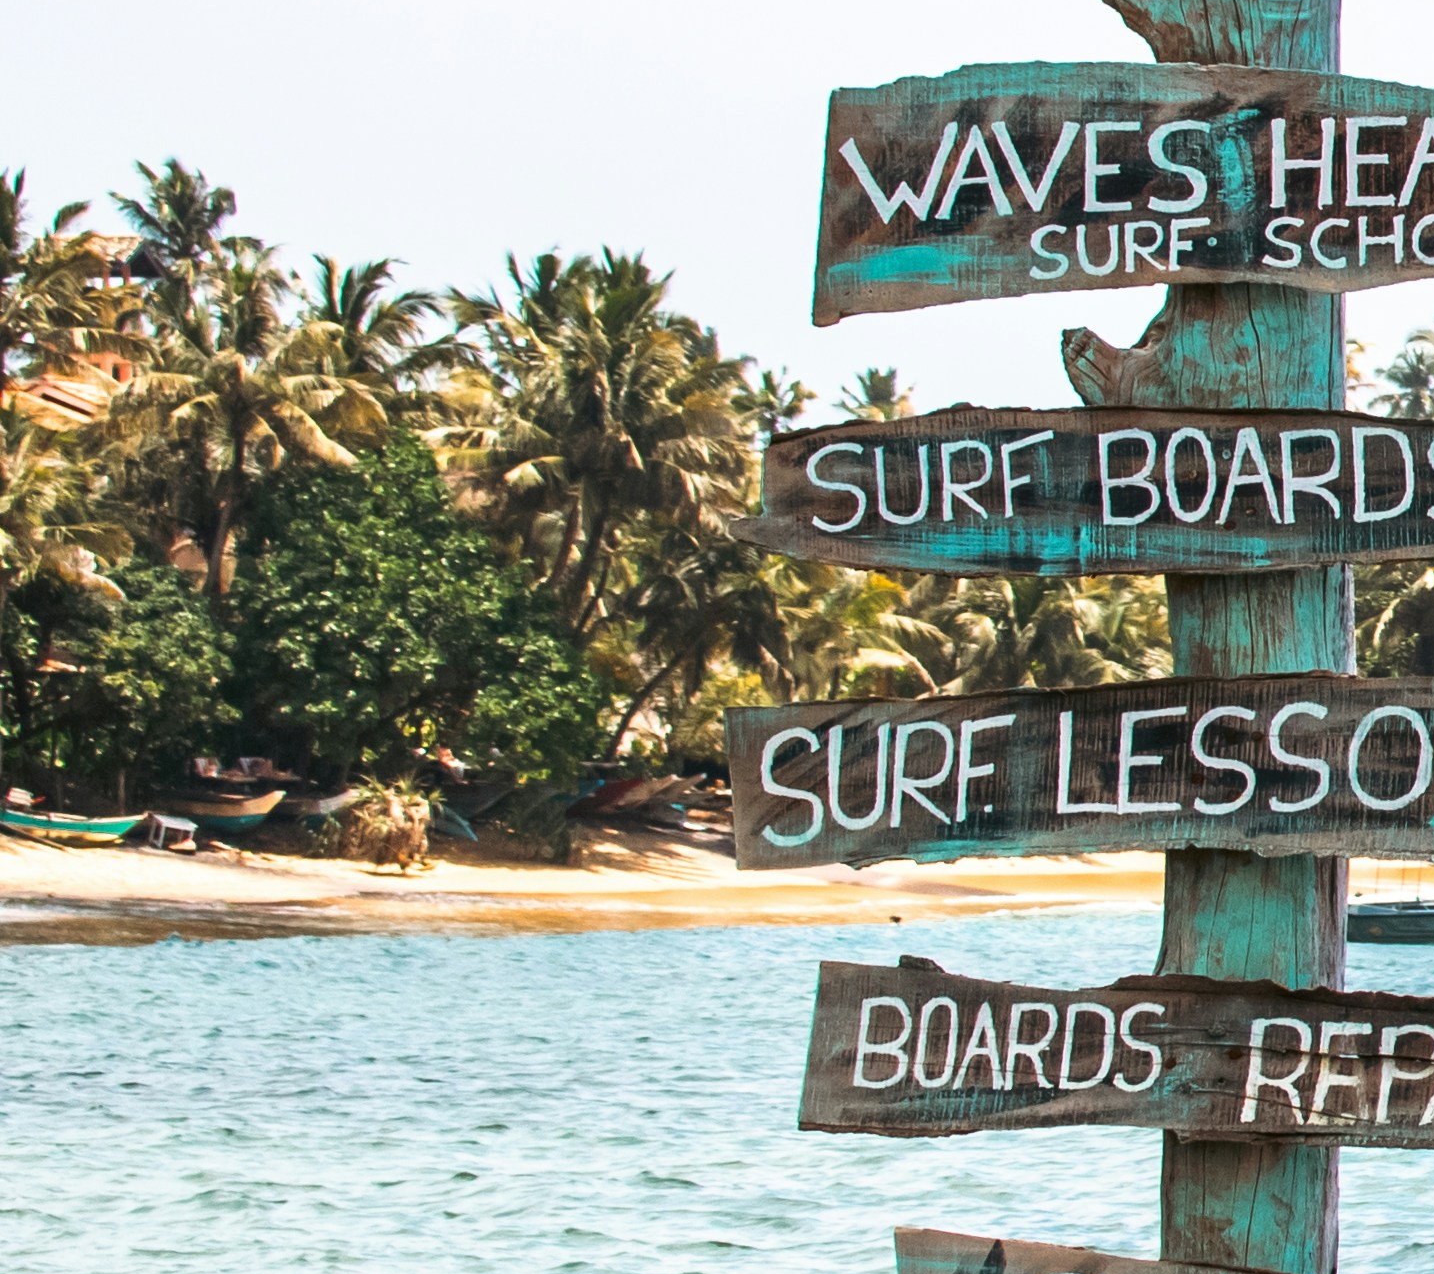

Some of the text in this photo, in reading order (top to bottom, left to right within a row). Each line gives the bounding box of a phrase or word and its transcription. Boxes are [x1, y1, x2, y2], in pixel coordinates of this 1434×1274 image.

[839, 120, 1211, 224] WAVES
[806, 430, 1054, 533] SURF
[853, 996, 1166, 1092] BOARDS
